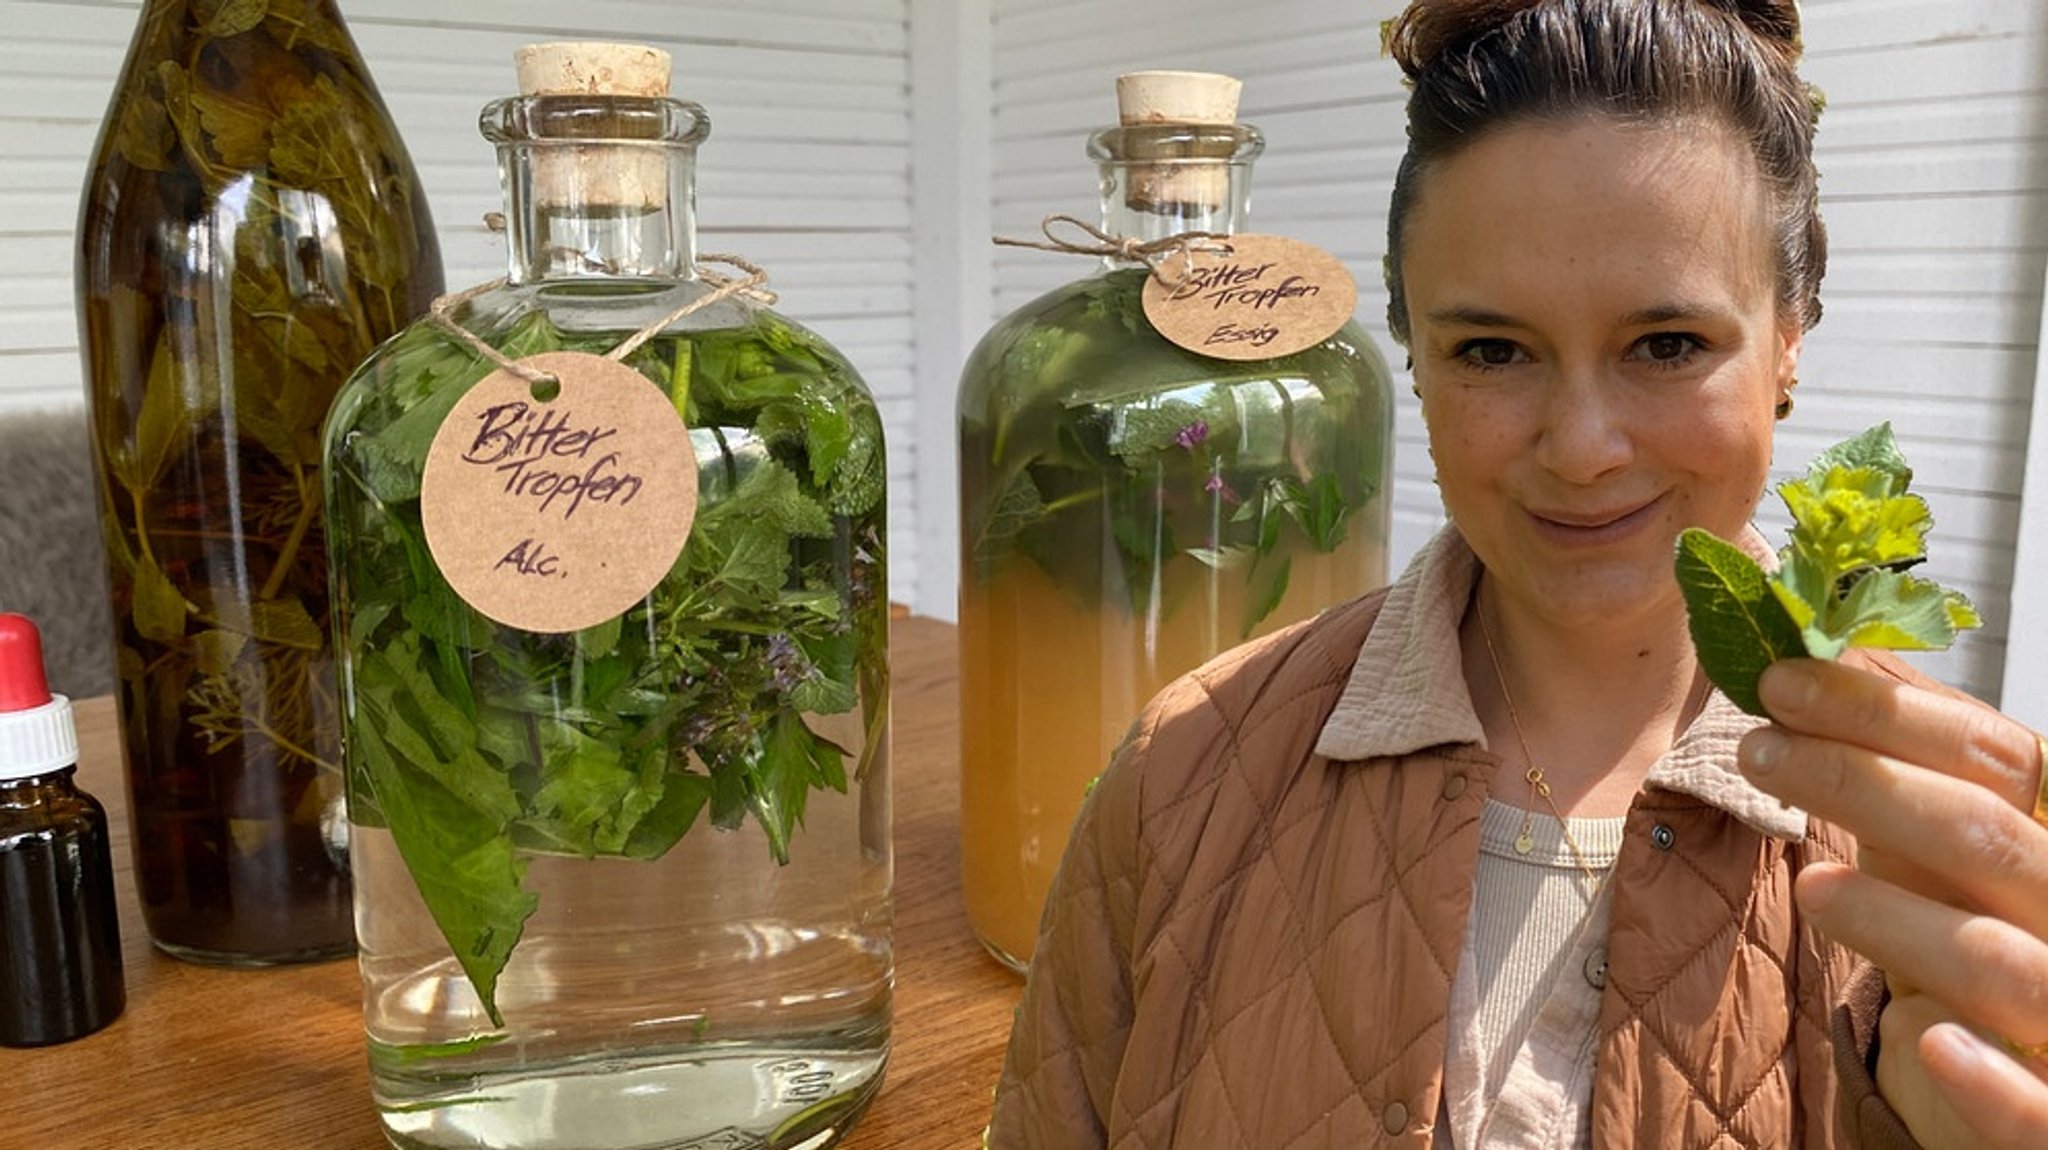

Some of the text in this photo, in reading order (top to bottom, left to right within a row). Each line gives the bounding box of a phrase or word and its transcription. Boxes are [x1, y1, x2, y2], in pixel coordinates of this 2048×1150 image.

[1203, 275, 1320, 310] Tropfen
[462, 401, 617, 465] Bitter
[496, 451, 643, 520] Tropfen
